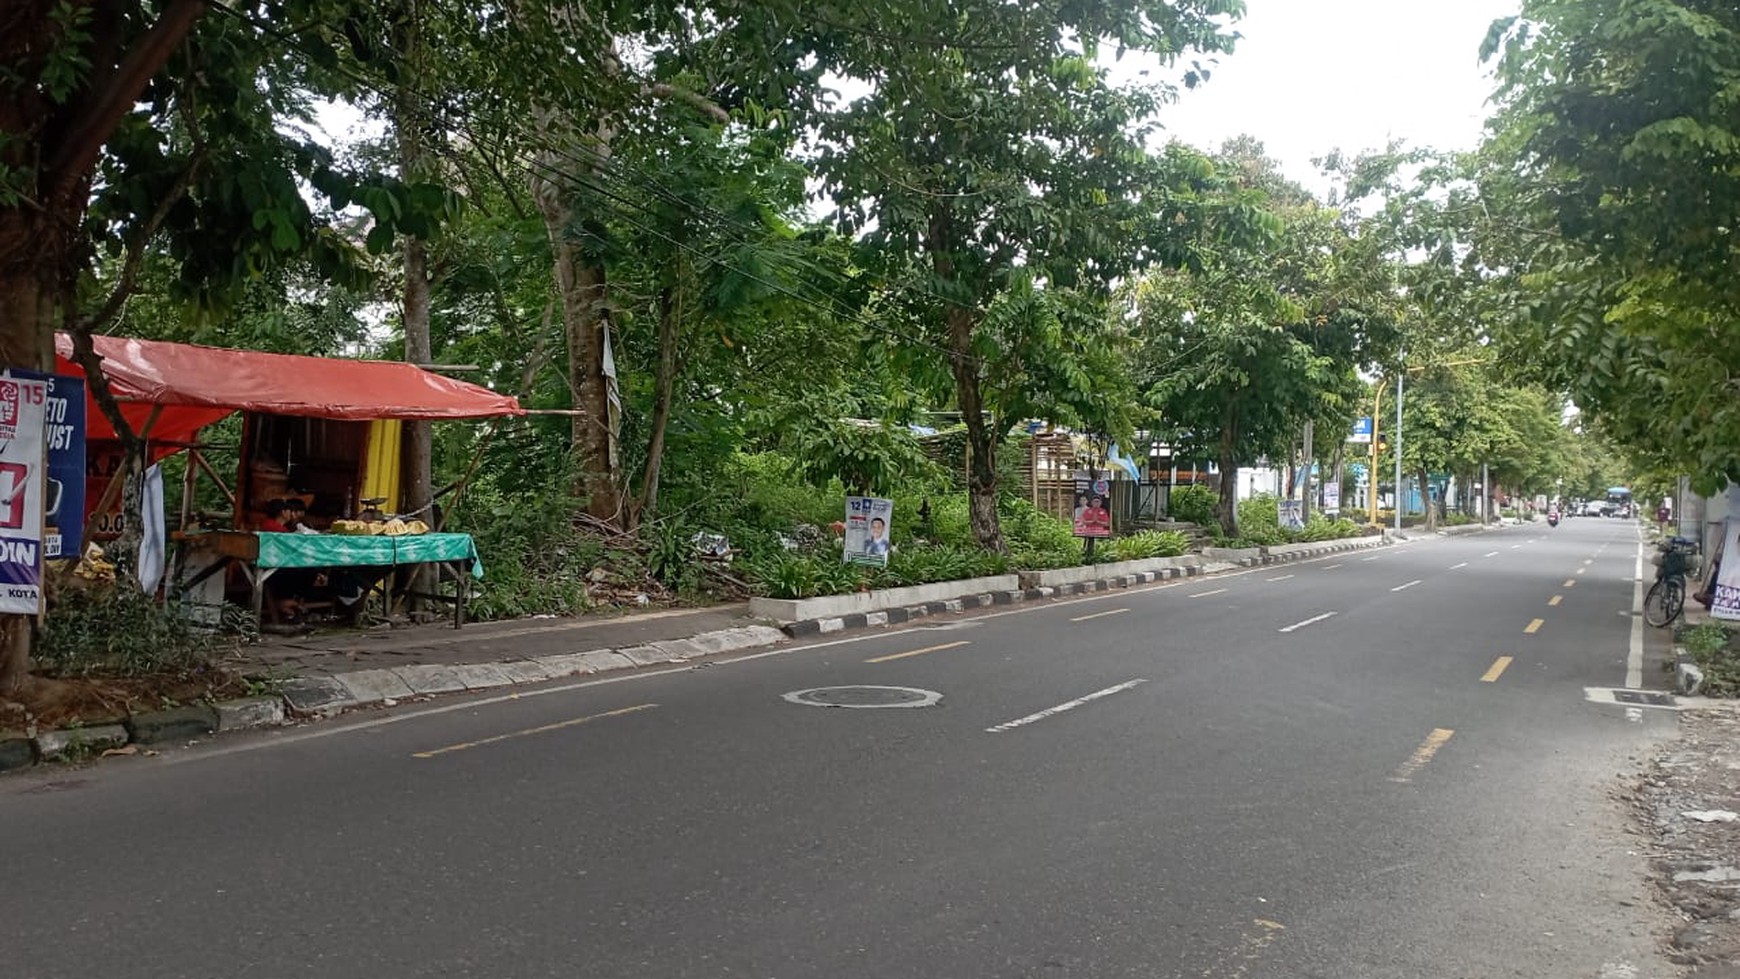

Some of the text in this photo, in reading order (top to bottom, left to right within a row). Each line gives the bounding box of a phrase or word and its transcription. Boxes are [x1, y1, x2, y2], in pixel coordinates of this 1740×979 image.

[22, 384, 44, 405] 15
[851, 501, 861, 511] 12
[8, 589, 38, 599] KOTA
